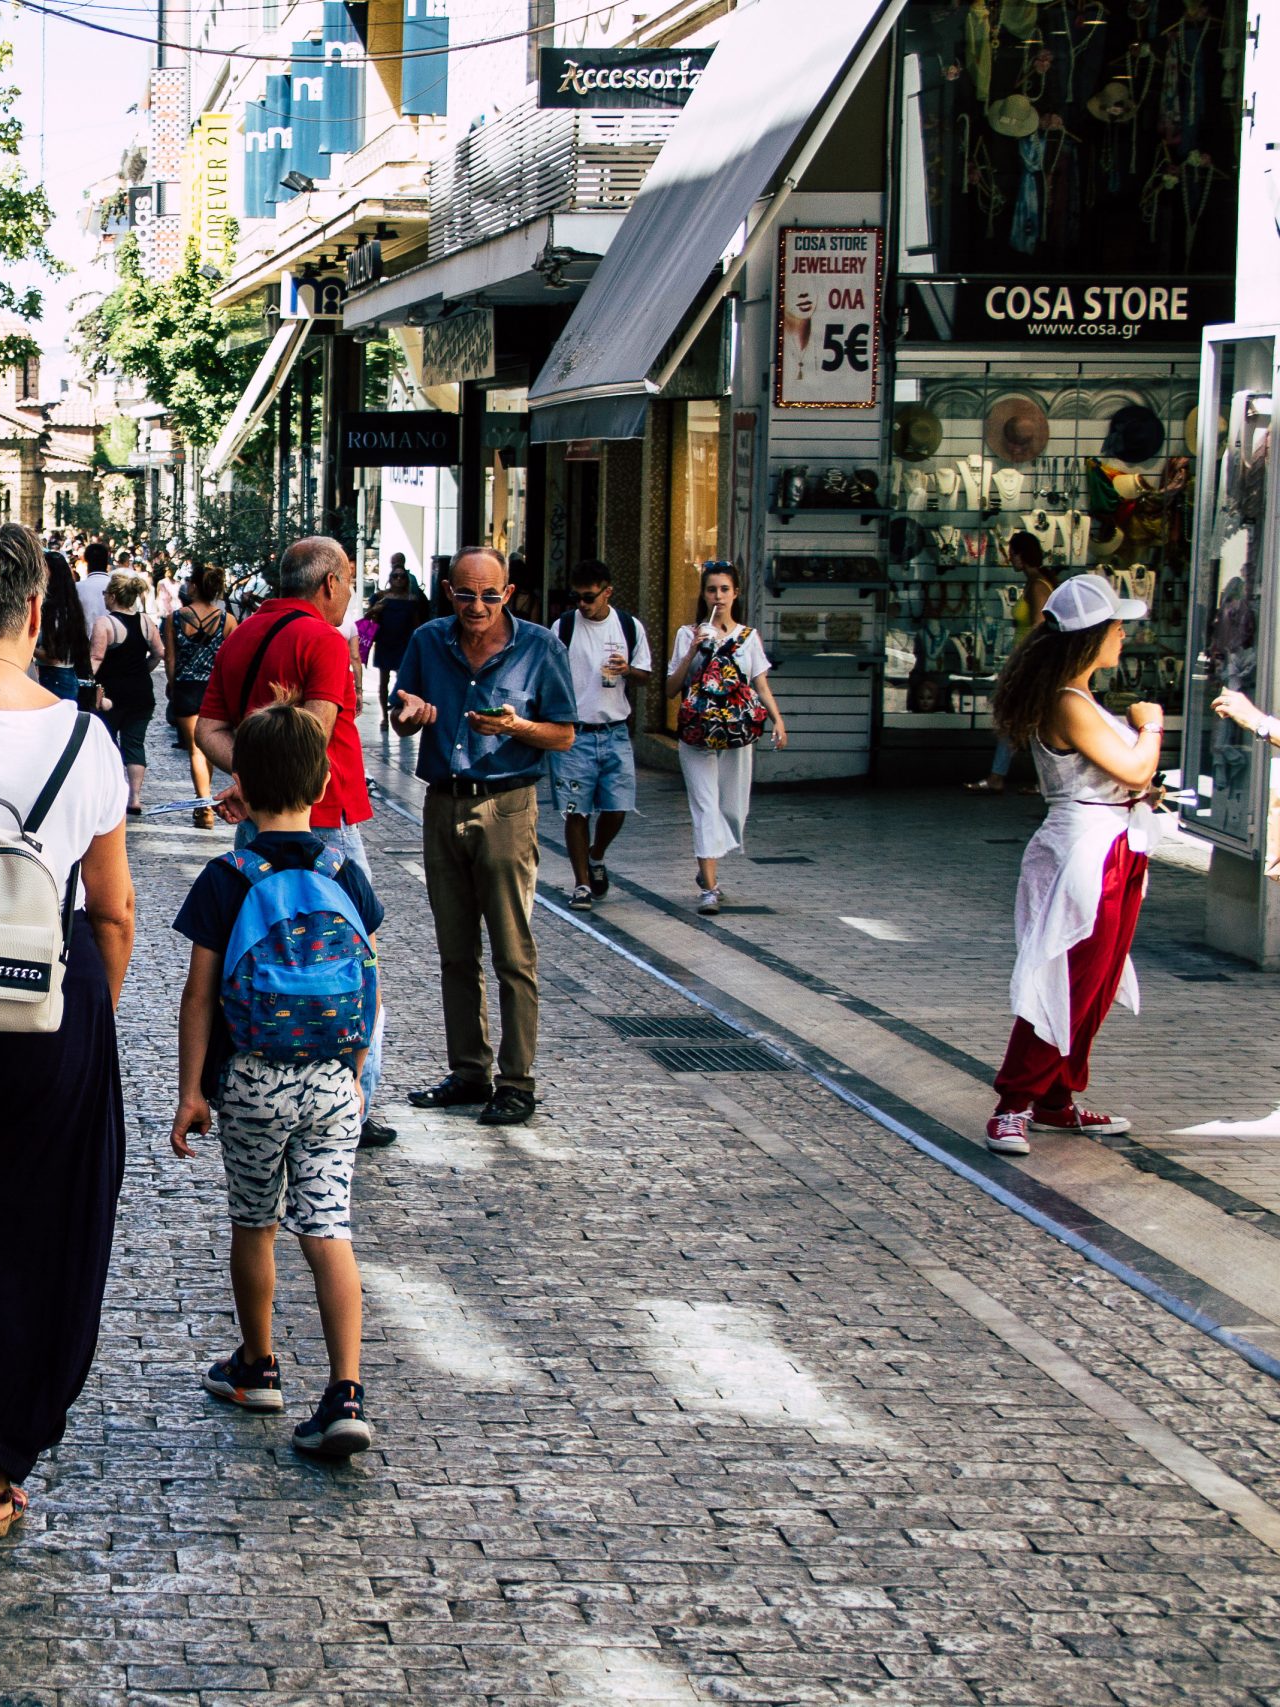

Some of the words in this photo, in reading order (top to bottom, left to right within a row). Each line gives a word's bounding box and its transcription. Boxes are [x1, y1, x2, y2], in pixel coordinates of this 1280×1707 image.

[207, 126, 227, 145] 21
[207, 158, 227, 252] FOREVER
[794, 236, 826, 250] COSA
[830, 236, 868, 250] STORE
[791, 257, 867, 274] JEWELLERY
[828, 288, 865, 309] ΟΛΑ
[985, 286, 1074, 320] COSA
[1083, 286, 1189, 321] STORE
[1027, 324, 1141, 339] www.cosa.gr
[821, 323, 870, 372] 5€
[348, 431, 447, 448] ROMANO
